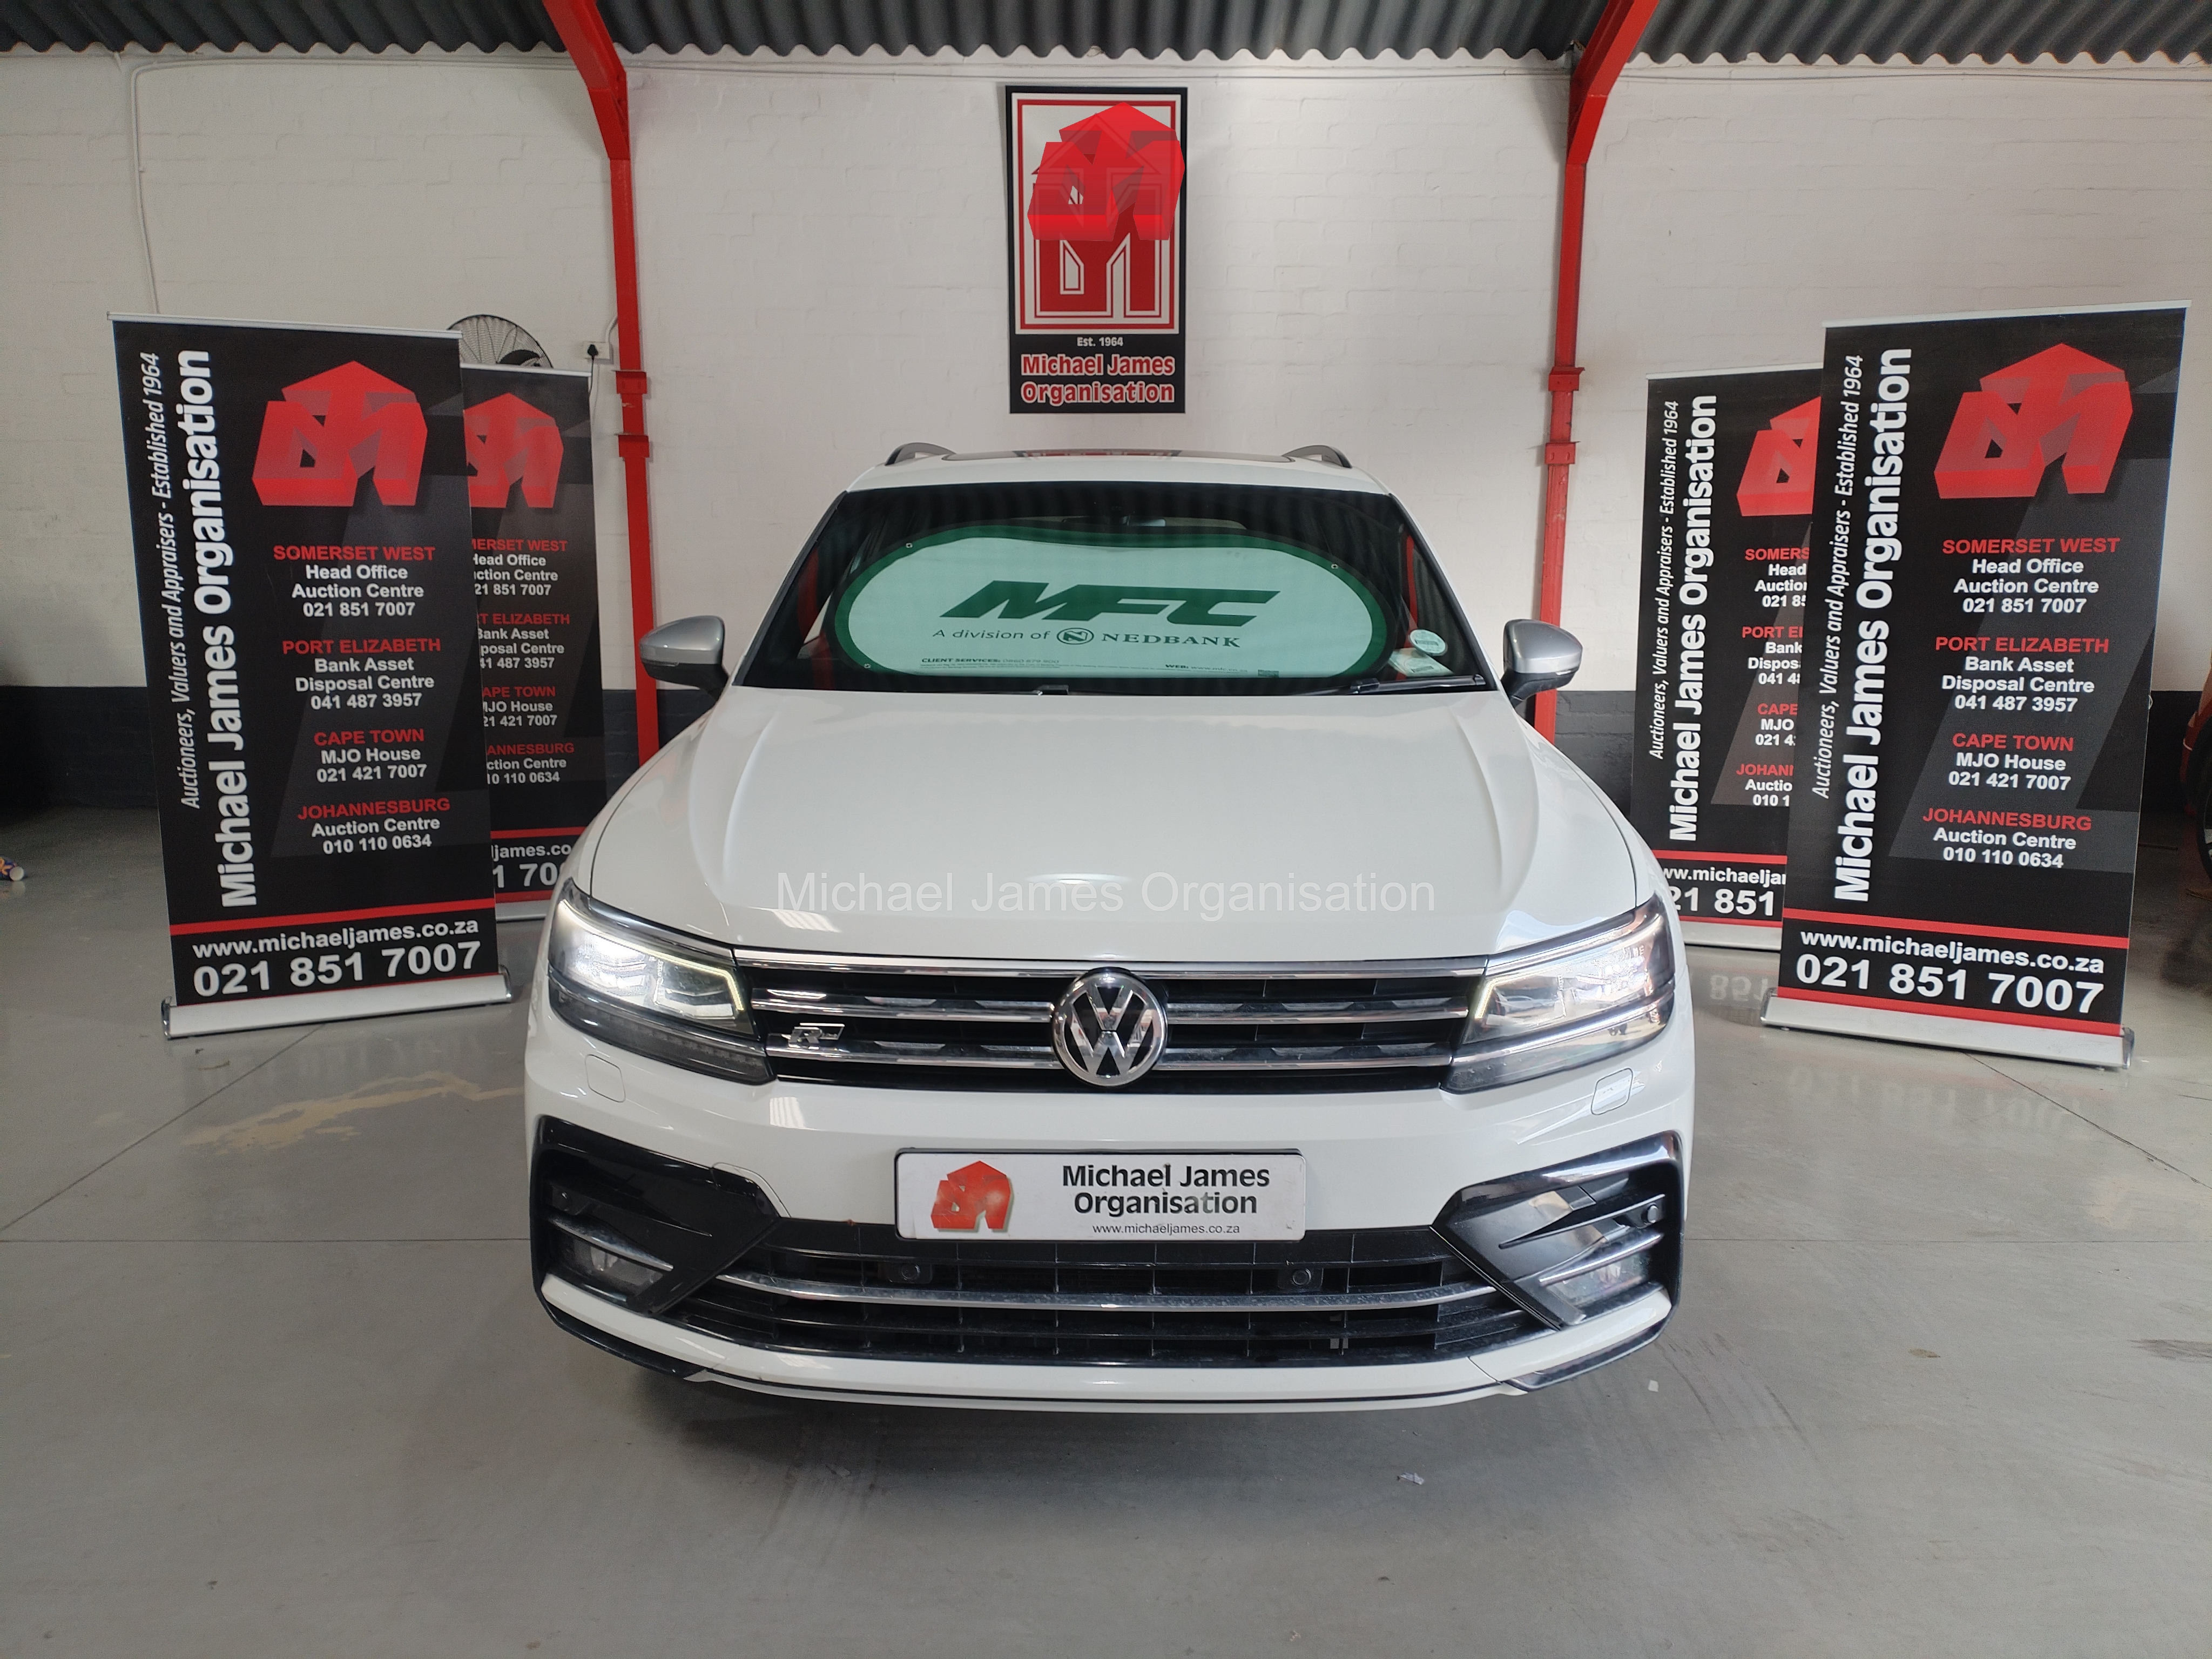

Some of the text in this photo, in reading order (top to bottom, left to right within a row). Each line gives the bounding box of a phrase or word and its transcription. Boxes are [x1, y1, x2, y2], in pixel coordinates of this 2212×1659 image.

[1077, 336, 1124, 347] Est. 1964
[1021, 354, 1175, 376] Michael James
[1021, 381, 1175, 406] Organisation
[273, 545, 436, 561] SOMERSET WEST
[527, 539, 568, 552] WEST
[1942, 537, 2121, 554] SOMERSET WEST
[507, 554, 547, 567] Office
[1745, 547, 1810, 561] SOMERS
[306, 564, 408, 579] Head Office
[1768, 563, 1807, 576] Head
[1972, 558, 2084, 574] Head Office
[140, 352, 200, 809] Auctioneers, Valuers and Appraisers Established 1964
[514, 569, 558, 581] Centre
[1649, 401, 1679, 760] Auctioneers, Valuers and Appraisers Established 1964
[1812, 355, 1863, 799] Auctioneers, Valuers and Appraisers Established 1964
[292, 583, 424, 598] Auction Centre
[493, 583, 551, 596] 851 7007
[1953, 578, 2099, 594] Auction Centre
[303, 602, 415, 617] 021 851 7007
[1762, 595, 1787, 608] 021
[1963, 598, 2087, 613] 021 851 7007
[492, 613, 570, 625] ELIZABETH
[1669, 395, 1717, 841] Michael James Organisation
[1834, 348, 1912, 902] Michael James Organisation
[176, 350, 257, 907] Michael James Organisation
[510, 628, 549, 639] Asset
[1742, 626, 1785, 638] PORT
[932, 628, 1241, 648] A division of NEDBANK
[1936, 637, 2109, 653] PORT ELIZABETH
[282, 638, 441, 655] PORT ELIZABETH
[521, 642, 564, 654] Centre
[1765, 642, 1803, 654] Bank
[314, 657, 415, 673] Bank Asset
[496, 657, 555, 669] 487 3957
[1965, 656, 2074, 673] Bank Asset
[295, 675, 435, 694] Disposal Centre
[1758, 672, 1783, 685] 041
[1941, 675, 2095, 693] Disposal Centre
[482, 685, 556, 698] APE TOWN
[311, 692, 422, 710] 041 487 3957
[510, 700, 553, 712] House
[1954, 694, 2078, 712] 041 487 3957
[1757, 703, 1798, 716] CAPE
[500, 714, 557, 727] 421 7007
[1761, 718, 1795, 731] MJO
[314, 729, 424, 746] CAPE TOWN
[1755, 733, 1779, 746] 021
[1952, 733, 2074, 752] CAPE TOWN
[321, 747, 421, 764] MJO House
[487, 743, 575, 756] ANNESBURG
[523, 758, 567, 769] Centre
[1956, 752, 2066, 771] MJO House
[316, 764, 427, 783] 021 421 7007
[504, 771, 560, 784] 110 0634
[1948, 771, 2072, 791] 021 421 7007
[1752, 794, 1779, 806] 010
[297, 798, 450, 820] JOHANNESBURG
[1923, 807, 2092, 831] JOHANNESBURG
[311, 817, 440, 838] Auction Centre
[323, 833, 432, 854] 010 110 0634
[1933, 827, 2076, 850] Auction Centre
[1943, 846, 2064, 868] 010 110 0634
[1714, 888, 1774, 916] 851
[192, 920, 480, 960] www.michaeljames.co.za
[1799, 930, 2105, 974] www.michaeljames.co.za
[193, 941, 481, 996] 021 851 7007
[1796, 954, 1870, 989] 021
[1889, 963, 1966, 1000] 851
[1988, 973, 2104, 1013] 7007
[1063, 1164, 1270, 1187] Michael James
[1074, 1191, 1257, 1218] Organisation
[1092, 1223, 1240, 1236] www.michaeljames.co.za
